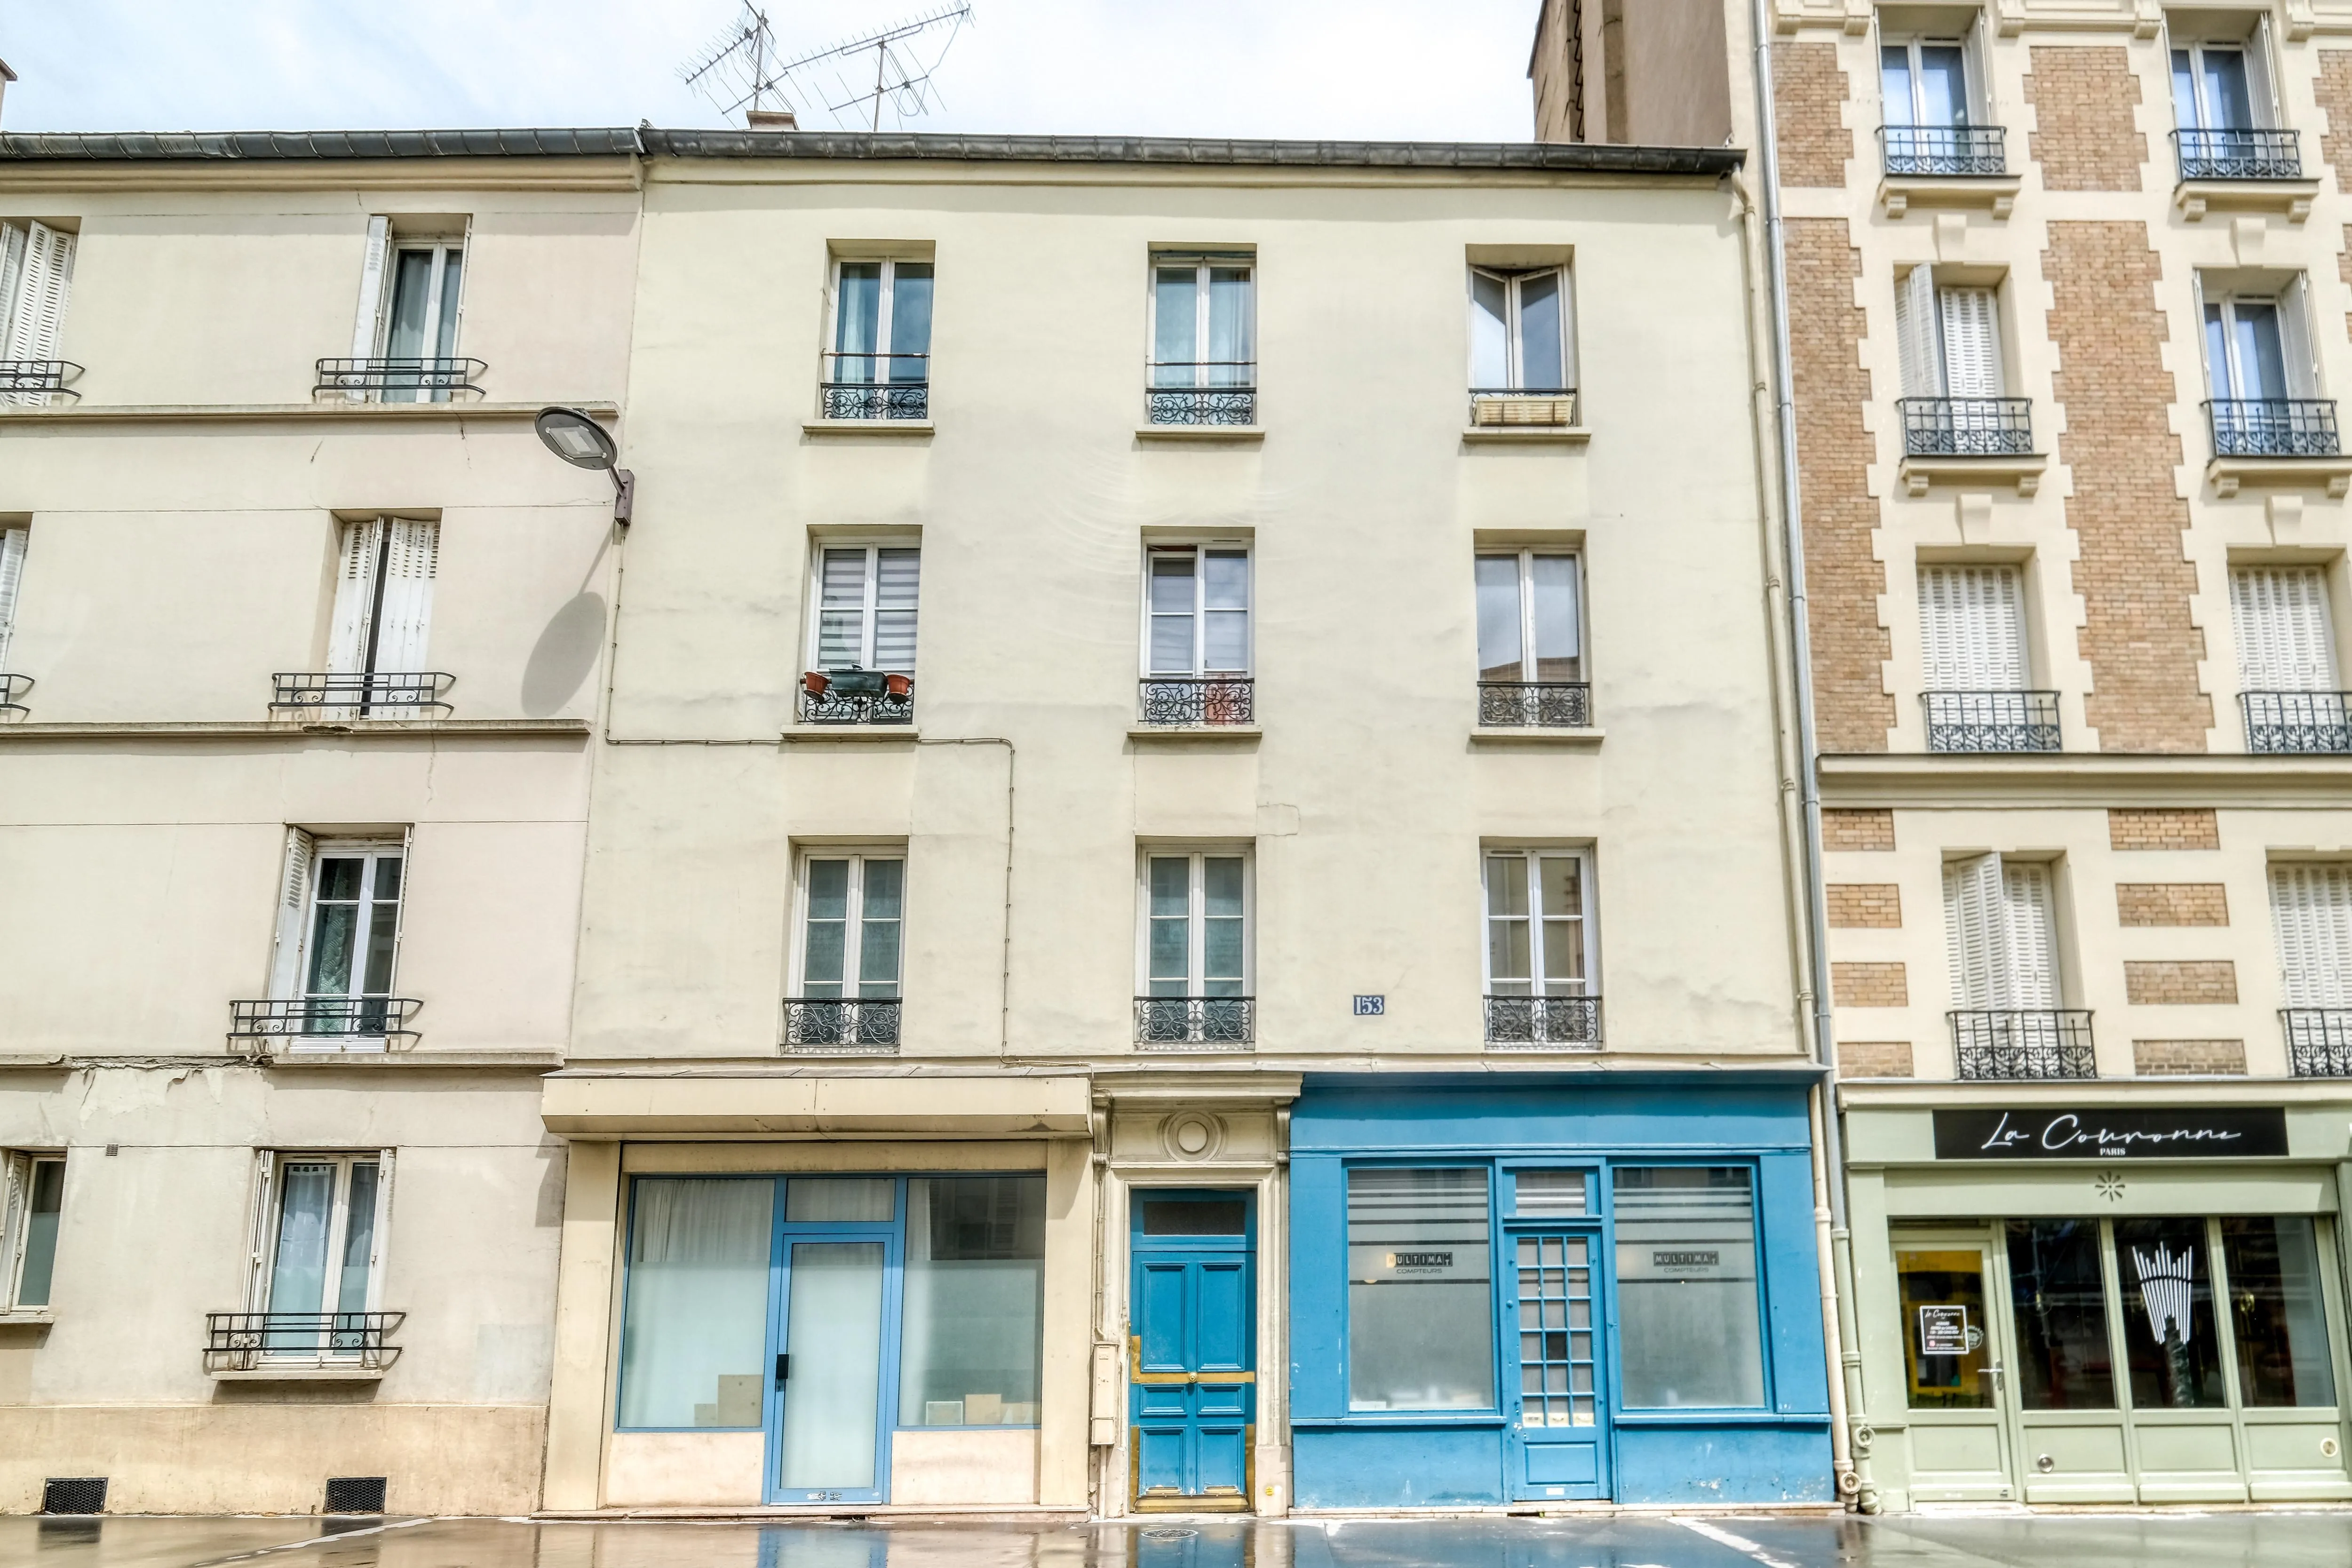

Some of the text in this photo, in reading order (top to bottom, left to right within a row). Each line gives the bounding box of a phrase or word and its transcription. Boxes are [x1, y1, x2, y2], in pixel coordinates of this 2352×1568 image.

[1355, 996, 1383, 1014] 153
[1981, 1111, 2241, 1150] La Couronne
[2099, 1147, 2126, 1156] PARIS
